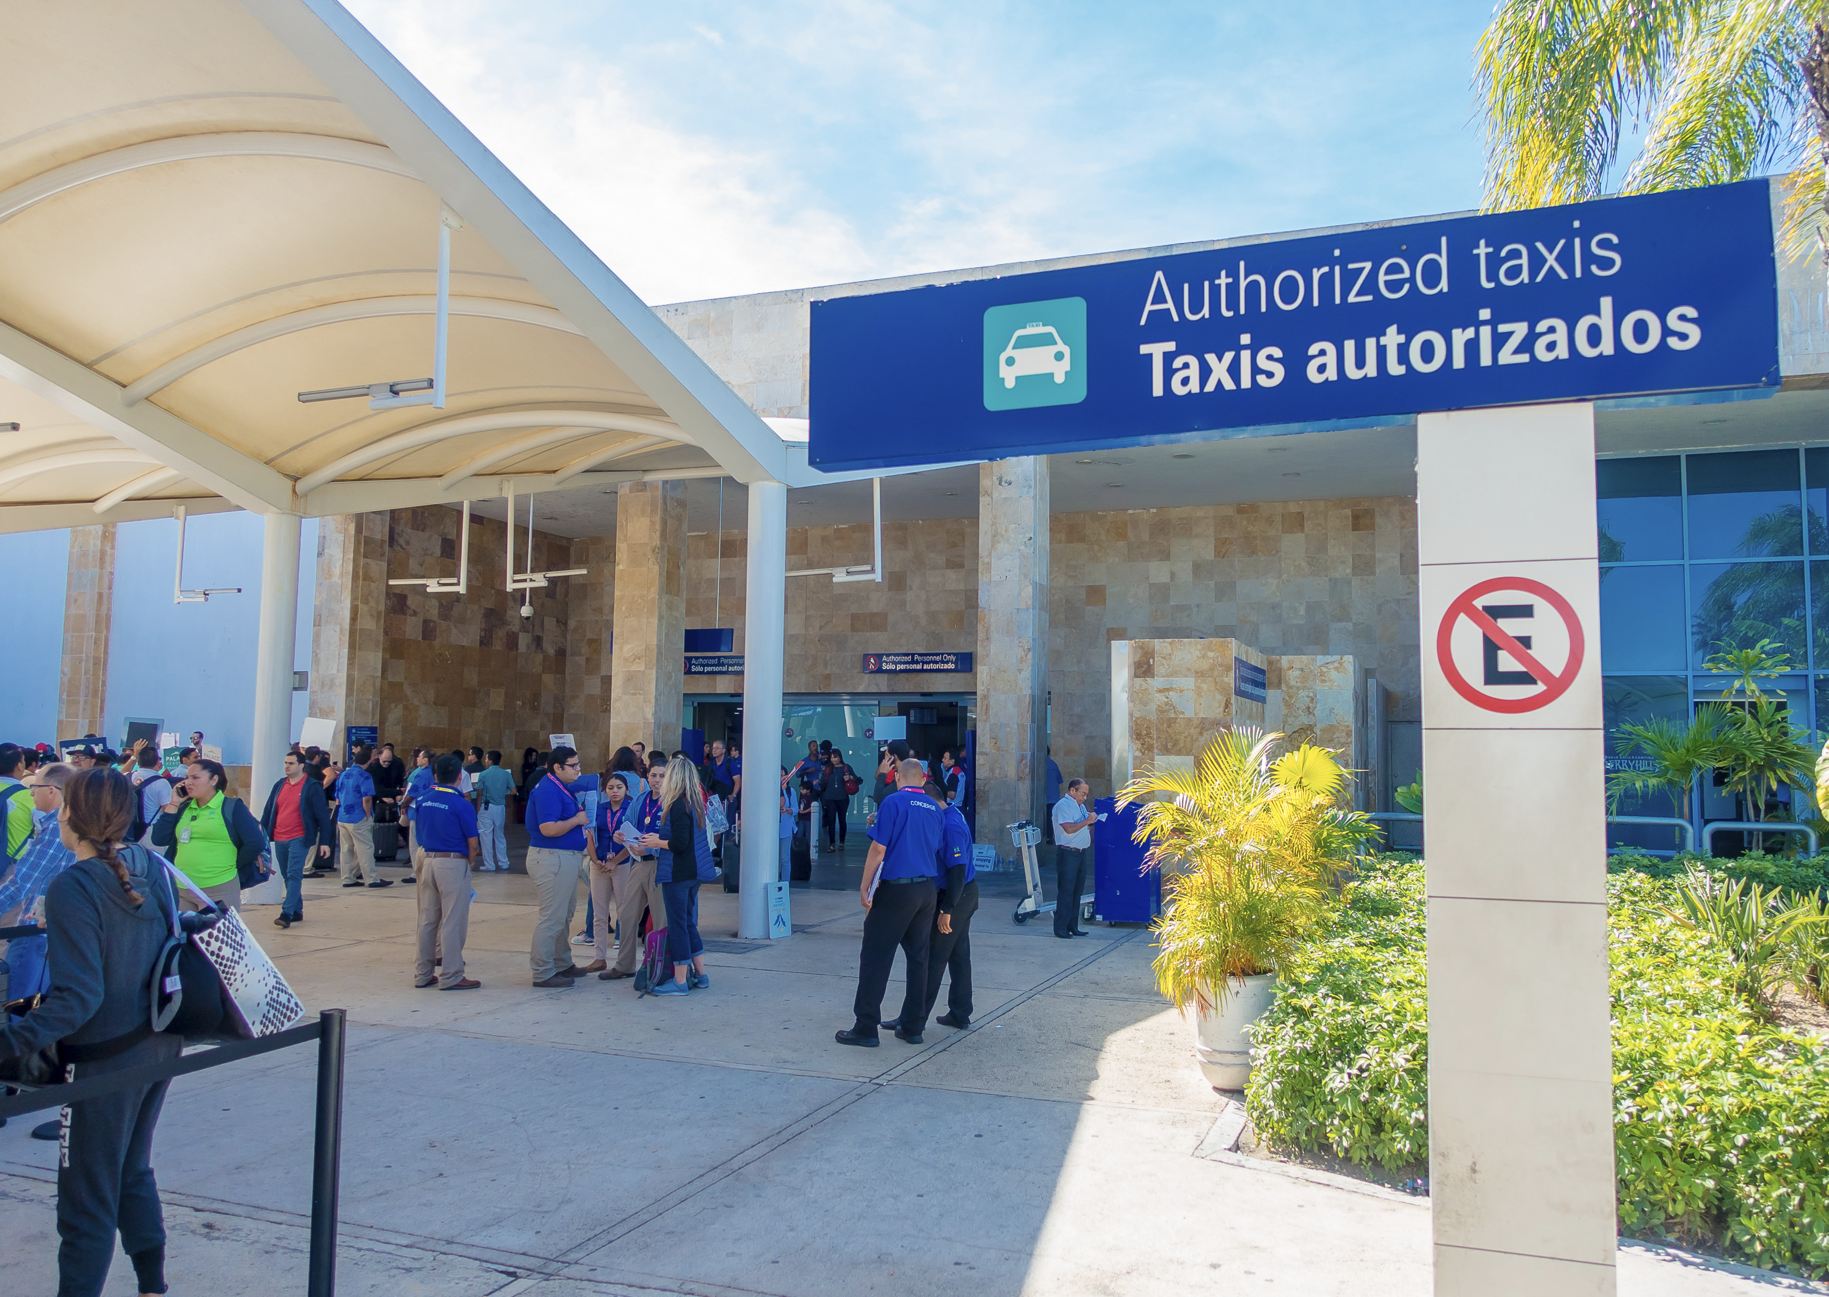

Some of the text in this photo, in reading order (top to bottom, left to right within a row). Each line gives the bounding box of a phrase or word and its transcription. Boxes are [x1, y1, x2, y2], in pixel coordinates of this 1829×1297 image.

[1139, 220, 1622, 326] Authorized taxis
[1139, 296, 1701, 397] Taxis autorizados
[896, 662, 922, 671] personal
[923, 661, 955, 670] autorizado
[942, 653, 956, 662] Only
[1482, 604, 1538, 686] E
